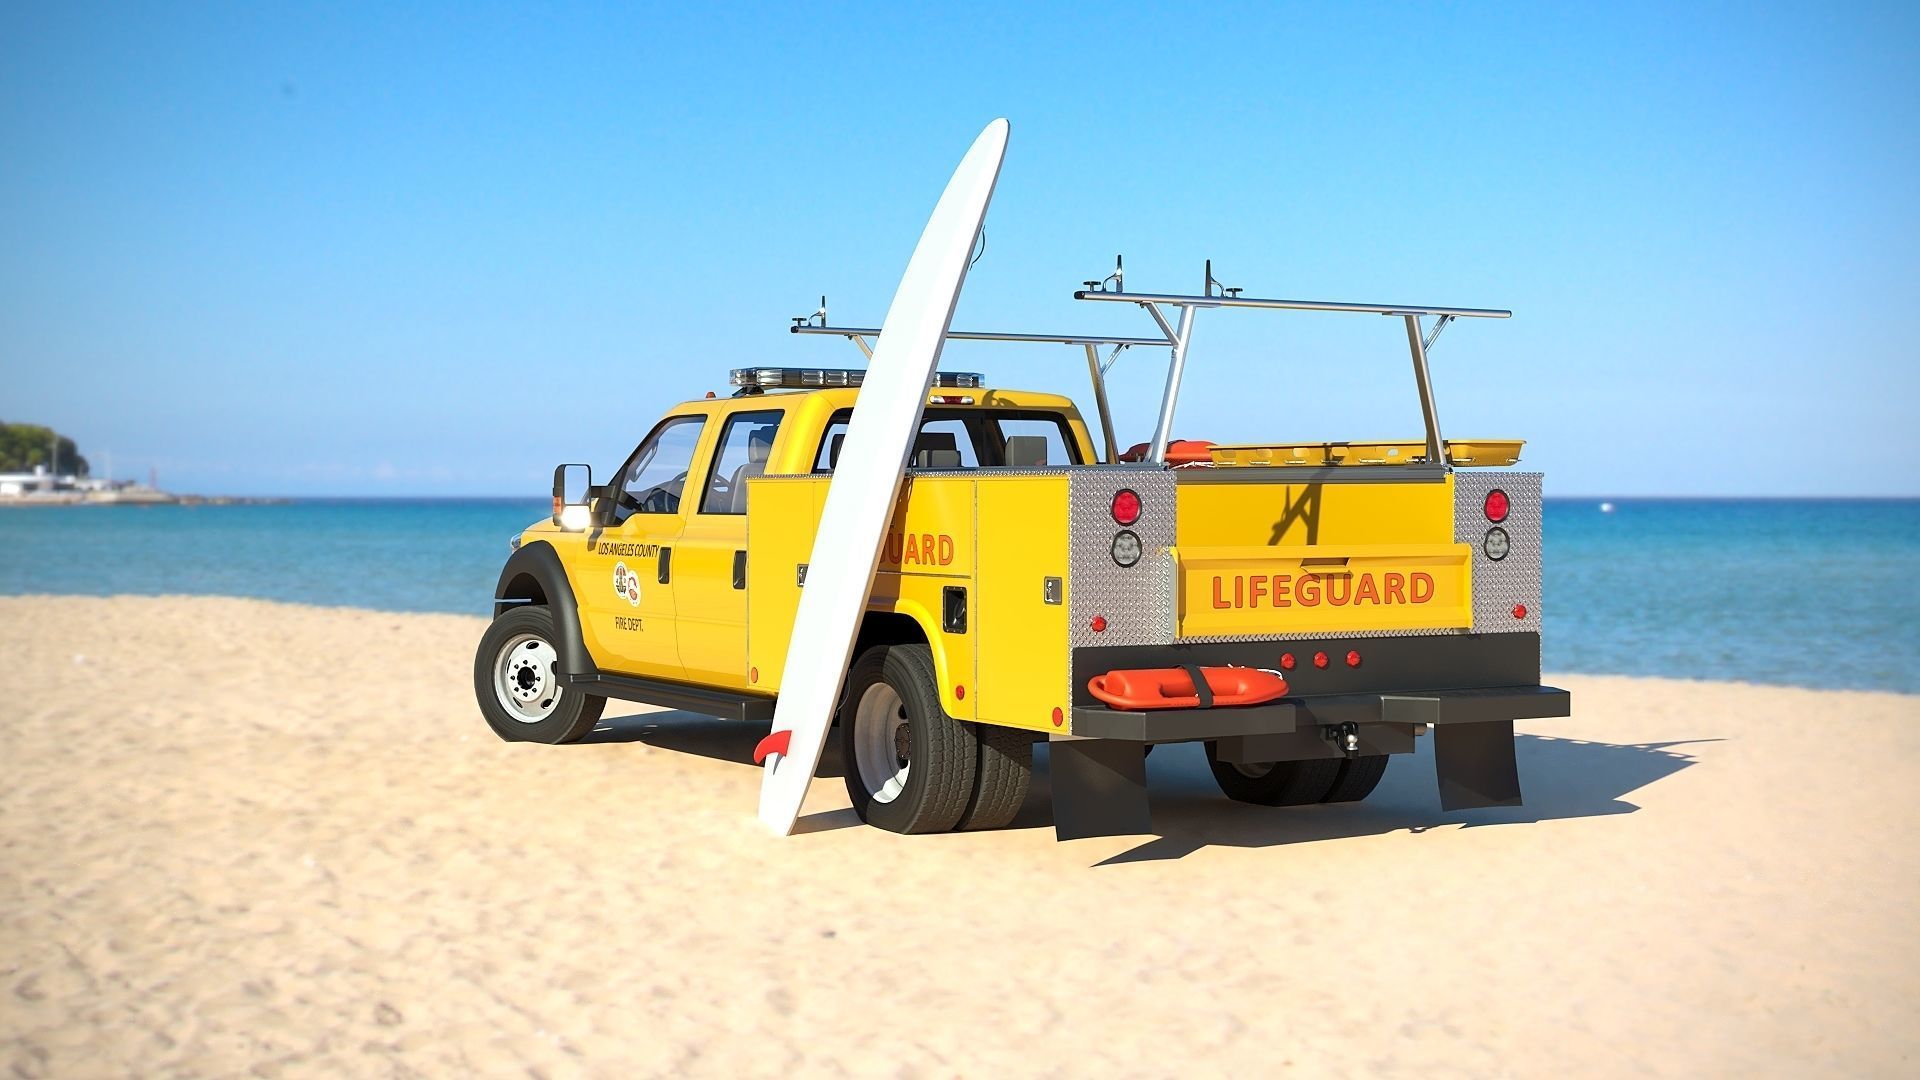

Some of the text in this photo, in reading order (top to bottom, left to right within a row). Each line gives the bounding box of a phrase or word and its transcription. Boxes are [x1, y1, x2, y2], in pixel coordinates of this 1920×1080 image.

[598, 543, 660, 558] LOS ANGELES COUNTY
[880, 533, 954, 565] UARD
[1212, 572, 1435, 608] LIFEGUARD
[615, 616, 643, 632] FIRE DEPT.
